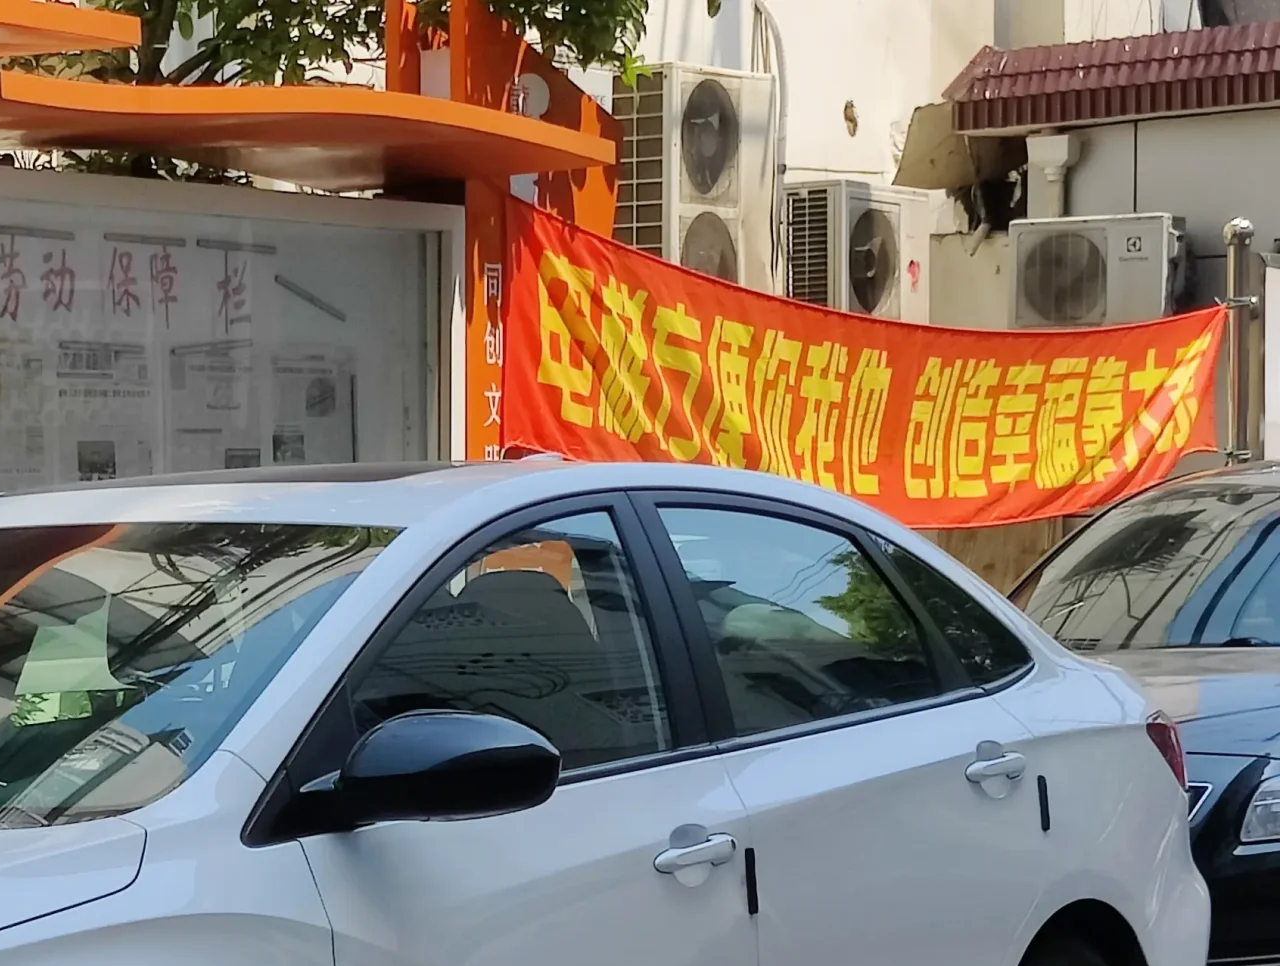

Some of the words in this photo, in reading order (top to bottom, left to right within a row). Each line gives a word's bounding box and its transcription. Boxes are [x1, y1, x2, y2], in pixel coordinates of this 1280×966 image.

[537, 250, 893, 495] 电梯方便你我他
[904, 331, 1212, 499] 创造幸福靠大家
